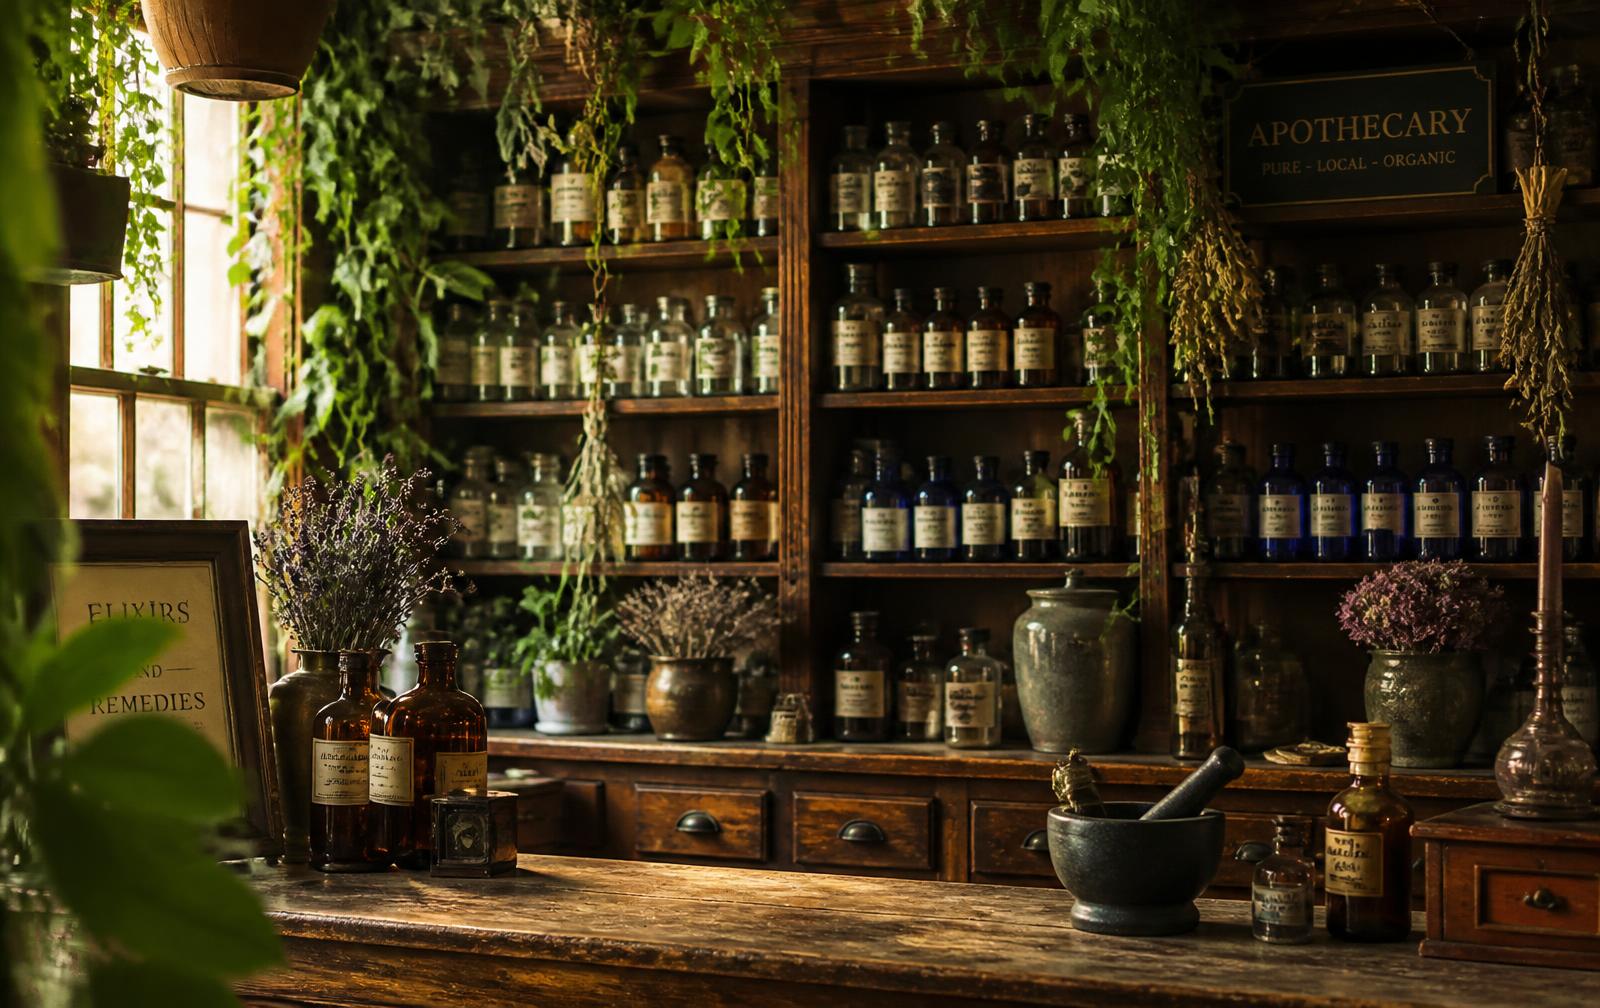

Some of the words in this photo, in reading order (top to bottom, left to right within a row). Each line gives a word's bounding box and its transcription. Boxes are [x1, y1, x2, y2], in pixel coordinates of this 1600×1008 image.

[1248, 107, 1473, 148] APOTHECARY
[1262, 161, 1302, 176] PURE
[1316, 156, 1368, 173] LOCAL
[1383, 151, 1456, 168] ORGANIC
[137, 665, 162, 678] ND
[91, 692, 206, 714] REMEDIES
